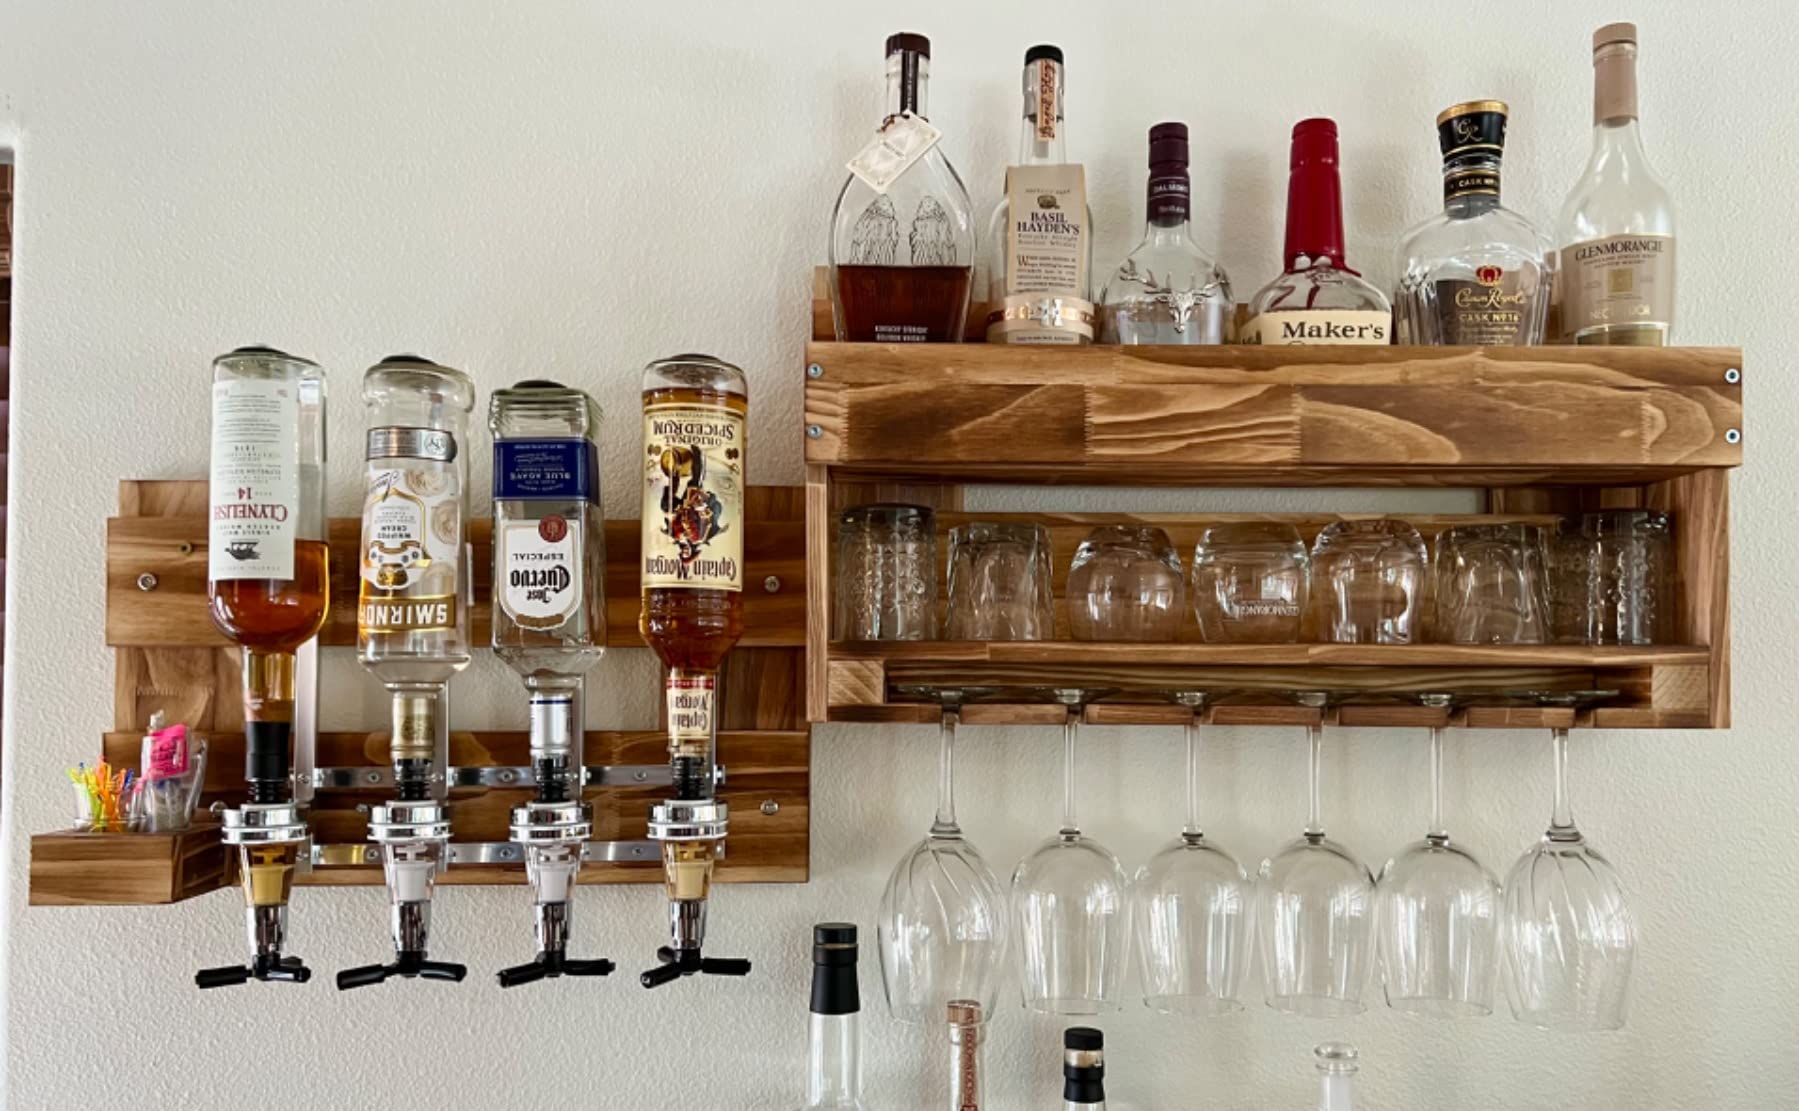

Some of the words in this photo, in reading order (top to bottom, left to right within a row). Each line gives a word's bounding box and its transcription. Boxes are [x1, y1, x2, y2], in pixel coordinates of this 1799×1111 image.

[1030, 211, 1067, 223] BASIL
[1016, 221, 1080, 235] HAYDEN'S
[1575, 240, 1665, 261] GLENMORANGIE
[1459, 312, 1489, 321] CASK
[1282, 320, 1384, 339] Maker's
[653, 420, 685, 436] RUM
[683, 421, 735, 440] SPICED
[664, 434, 723, 447] ORIGINAL
[509, 471, 542, 481] AGAVE
[237, 487, 253, 500] 14
[213, 503, 288, 522] CLYNELISH
[512, 553, 564, 561] ESPECIAL
[645, 555, 693, 580] Morgan
[694, 556, 737, 581] Captain
[510, 565, 571, 593] Cuervo
[526, 588, 552, 604] Jose
[670, 692, 709, 711] Morga
